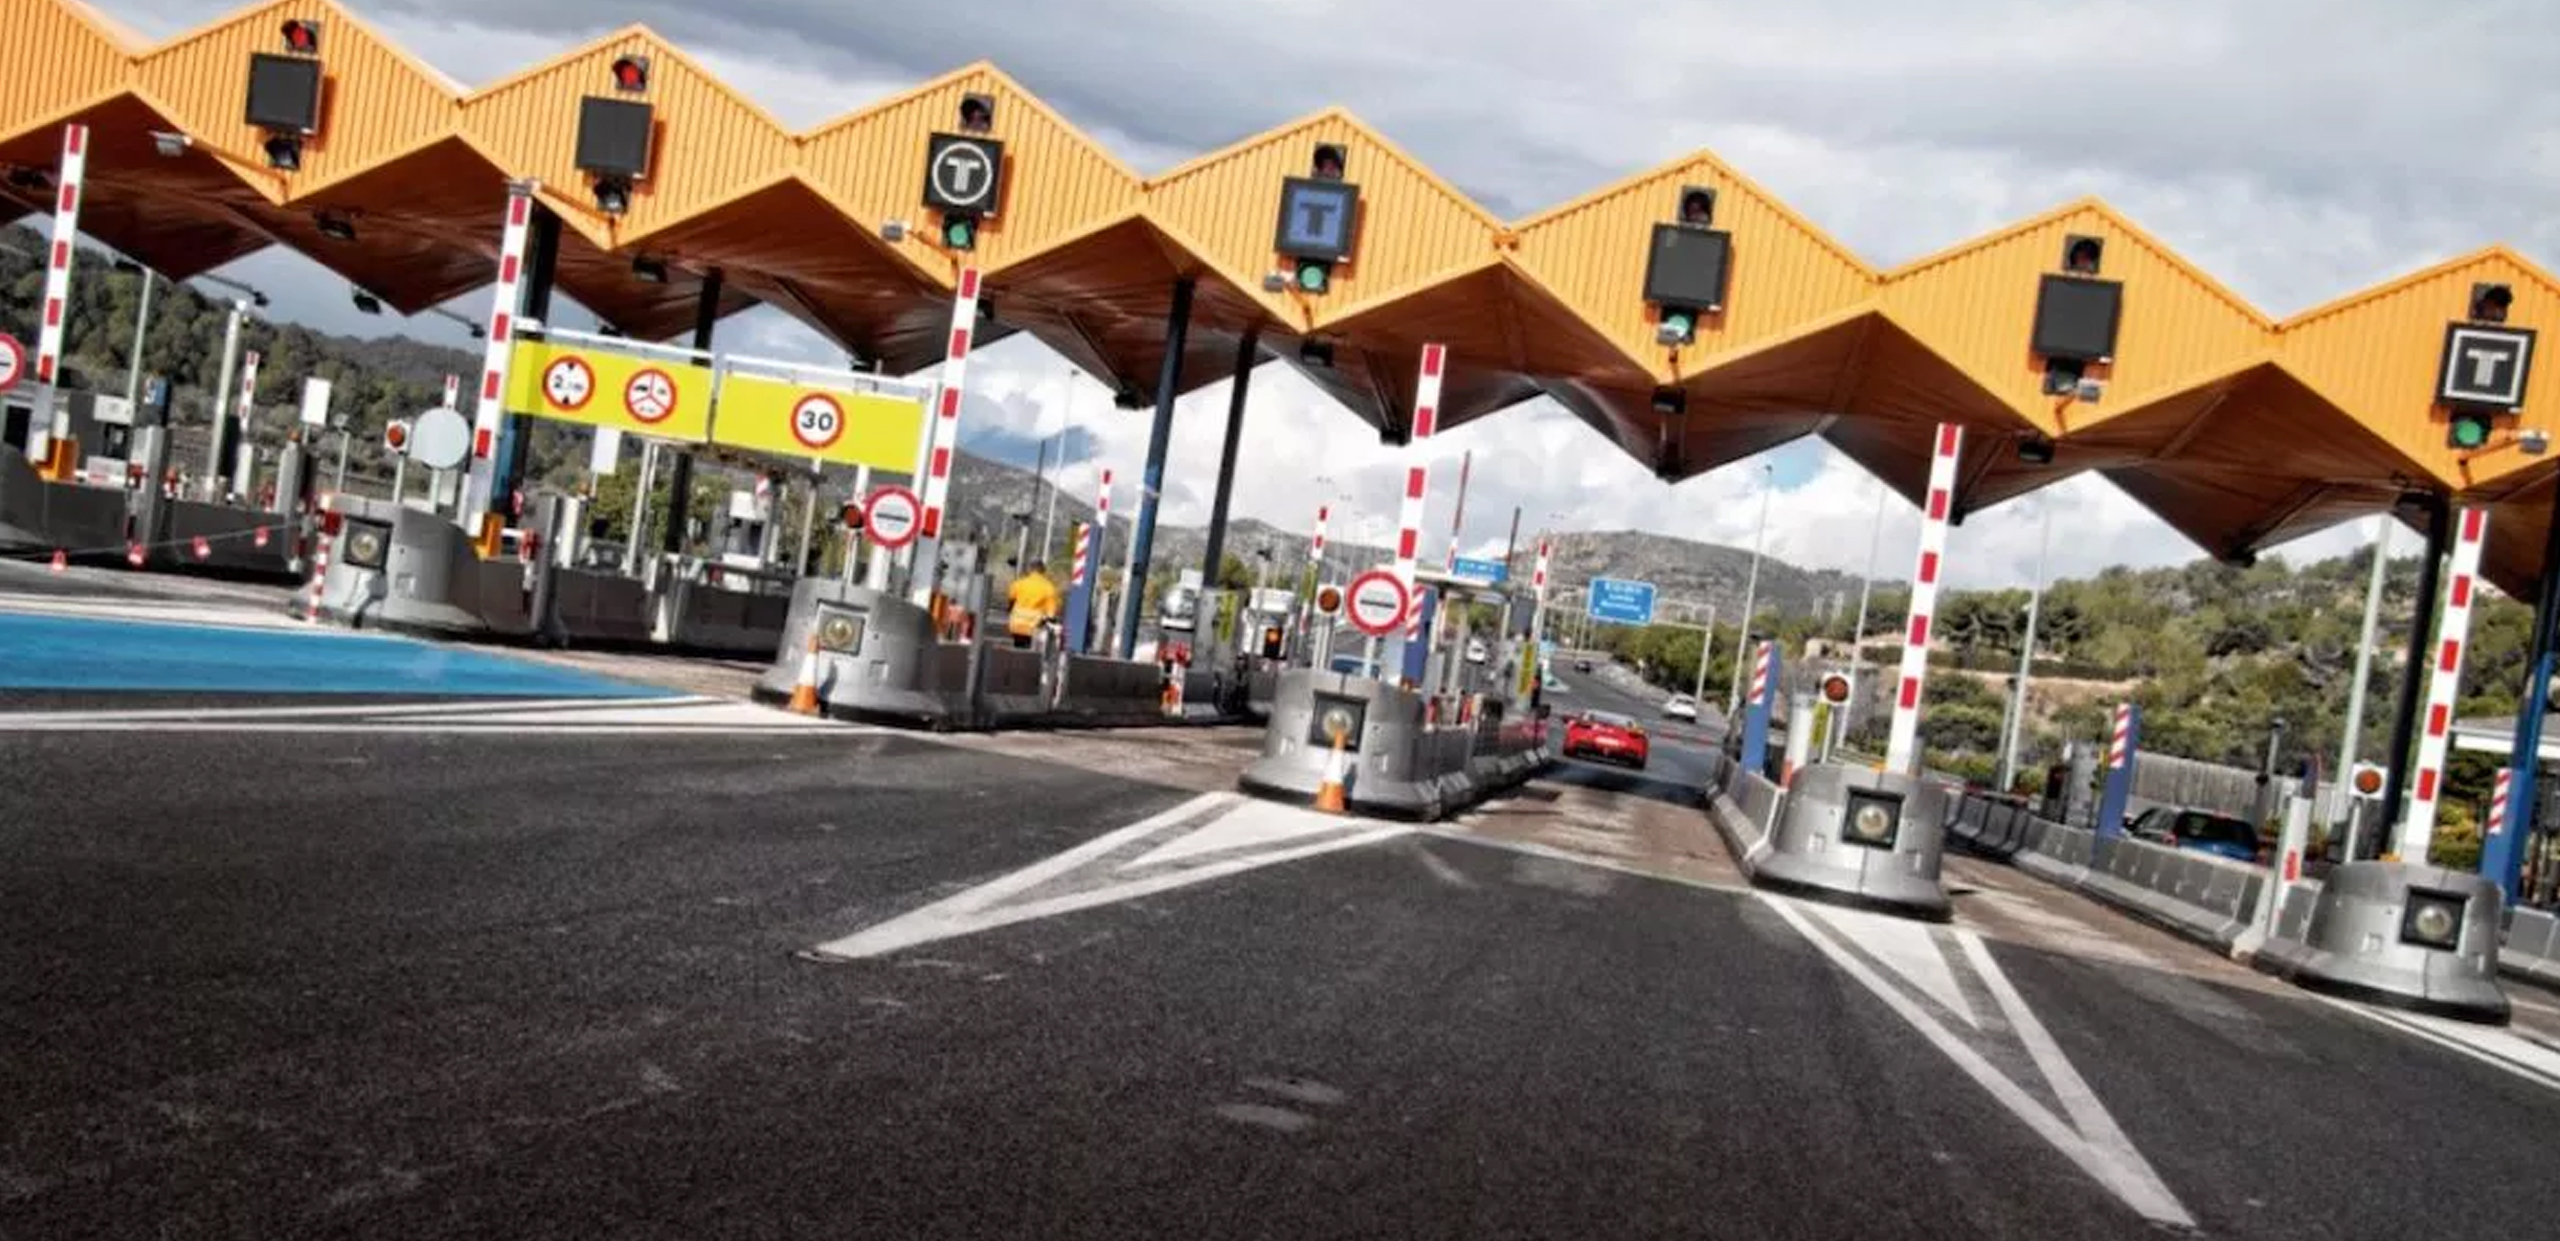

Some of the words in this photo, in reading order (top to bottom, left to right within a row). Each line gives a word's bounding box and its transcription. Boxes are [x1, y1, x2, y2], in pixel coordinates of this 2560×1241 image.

[947, 157, 980, 192] T
[1300, 202, 1338, 237] T
[2467, 349, 2509, 386] T
[801, 410, 833, 432] 30
